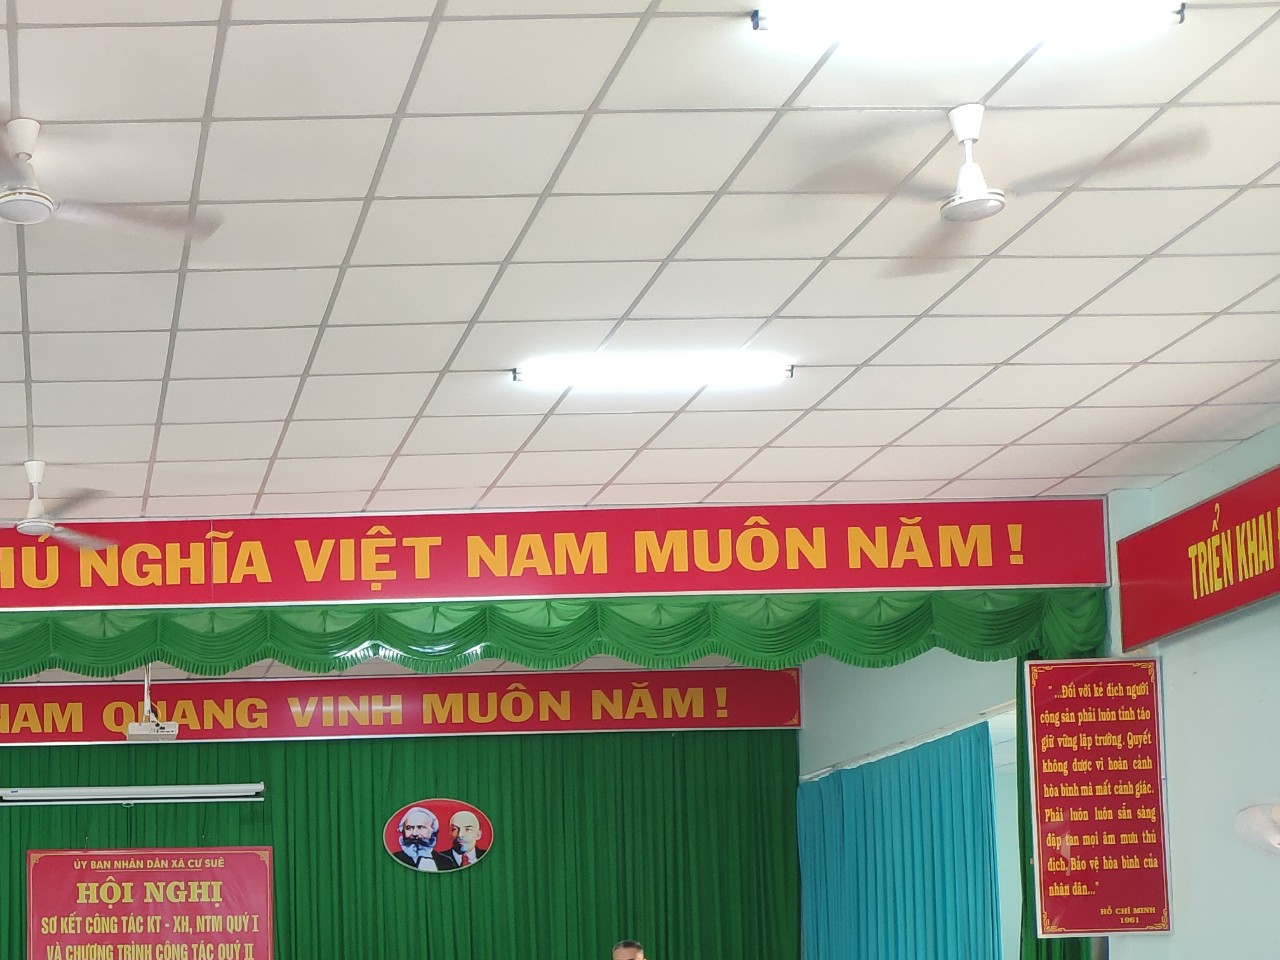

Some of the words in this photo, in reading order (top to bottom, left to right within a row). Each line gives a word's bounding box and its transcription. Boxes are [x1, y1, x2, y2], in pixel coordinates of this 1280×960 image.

[80, 530, 272, 588] NGHĨA
[294, 525, 442, 591] VIỆT
[467, 531, 608, 578] NAM
[634, 515, 827, 574] MUÔN
[1188, 503, 1233, 600] TRIỂN
[1236, 511, 1274, 582] KHAI
[1079, 685, 1092, 698] với
[1093, 682, 1103, 697] kẻ
[1106, 682, 1124, 700] địch
[1127, 682, 1149, 699] người
[287, 694, 403, 728] VINH
[422, 682, 571, 724] MUÔN
[1040, 710, 1060, 727] cộng
[1061, 708, 1075, 722] sản
[1078, 707, 1095, 726] phải
[1098, 708, 1116, 721] luôn
[1118, 706, 1135, 720] tỉnh
[1137, 707, 1150, 720] táo
[1041, 734, 1054, 752] giữ
[1058, 734, 1078, 751] vững
[1080, 733, 1092, 750] lập
[1127, 728, 1152, 748] Quyết
[1043, 758, 1068, 776] không
[1072, 758, 1092, 774] được
[1096, 758, 1104, 771] vì
[1108, 756, 1128, 770] hoàn
[1133, 754, 1152, 769] cảnh
[1044, 784, 1058, 798] hòa
[1061, 782, 1079, 796] bình
[1081, 782, 1093, 796] mà
[1096, 779, 1111, 795] mất
[1114, 778, 1134, 794] cảnh
[1135, 778, 1154, 798] giác.
[1045, 806, 1063, 822] Phải
[1070, 807, 1088, 821] luôn
[1095, 806, 1113, 820] luôn
[1137, 804, 1156, 822] sàng
[1046, 832, 1061, 850] đập
[1083, 831, 1098, 848] mọi
[1103, 832, 1116, 845] âm
[1121, 833, 1138, 844] mưu
[1142, 829, 1156, 843] thủ
[73, 857, 87, 870] ỦY
[90, 860, 110, 869] BAN
[114, 857, 143, 869] NHÂN
[147, 857, 169, 868] DÂN
[172, 857, 185, 868] XÃ
[187, 858, 202, 868] CƯ
[204, 856, 224, 868] SUÊ
[1071, 855, 1086, 871] Bảo
[1090, 857, 1100, 872] vệ
[1103, 856, 1118, 870] hòa
[1122, 854, 1140, 869] bình
[1144, 853, 1158, 868] của
[76, 876, 133, 909] HỘI
[144, 881, 223, 907] NGHỊ
[1049, 882, 1070, 896] nhân
[1100, 905, 1112, 915] HỒ
[1116, 906, 1130, 915] CHÍ
[41, 915, 58, 934] SƠ
[61, 912, 81, 934] KẾT
[86, 913, 118, 934] CÔNG
[121, 913, 143, 934] TÁC
[147, 916, 161, 933] KT
[173, 916, 192, 935] XH,
[196, 916, 222, 932] NTM
[226, 912, 249, 933] QUÝ
[252, 915, 258, 932] I
[118, 941, 152, 960] TRÌNH
[156, 940, 188, 960] CÔNG
[192, 941, 214, 960] TÁC
[244, 944, 254, 960] II
